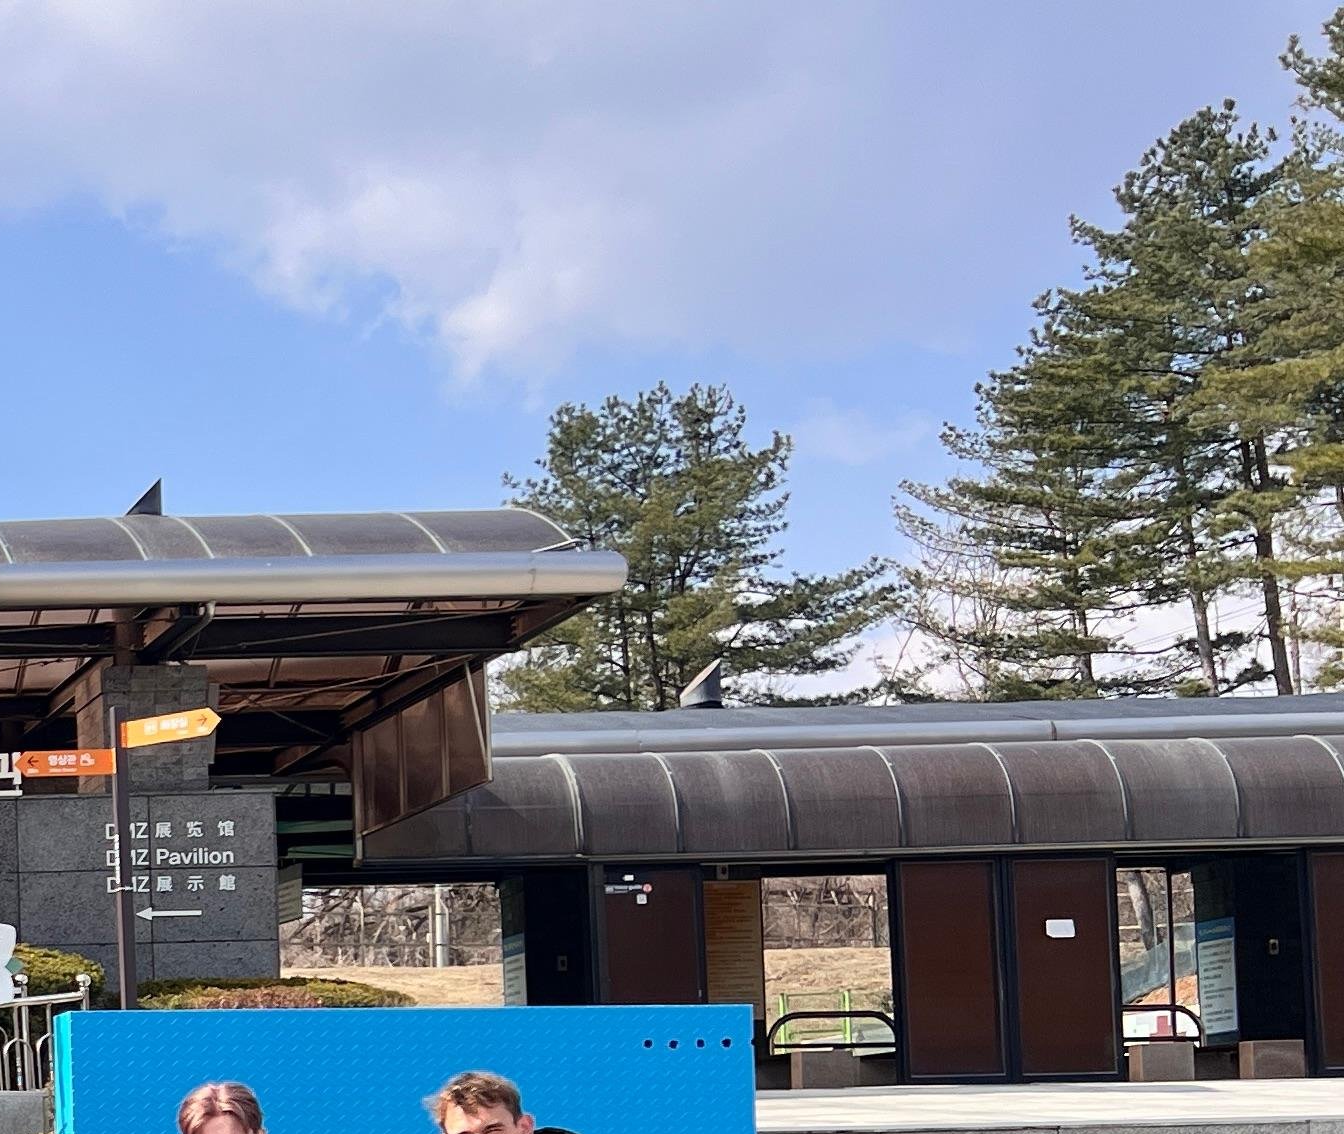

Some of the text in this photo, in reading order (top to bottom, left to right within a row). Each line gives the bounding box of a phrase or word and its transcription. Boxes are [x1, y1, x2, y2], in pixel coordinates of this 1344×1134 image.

[105, 820, 235, 840] DZ 展览馆
[106, 847, 235, 867] DZ Pavilion
[107, 874, 236, 893] DZ 展示館
